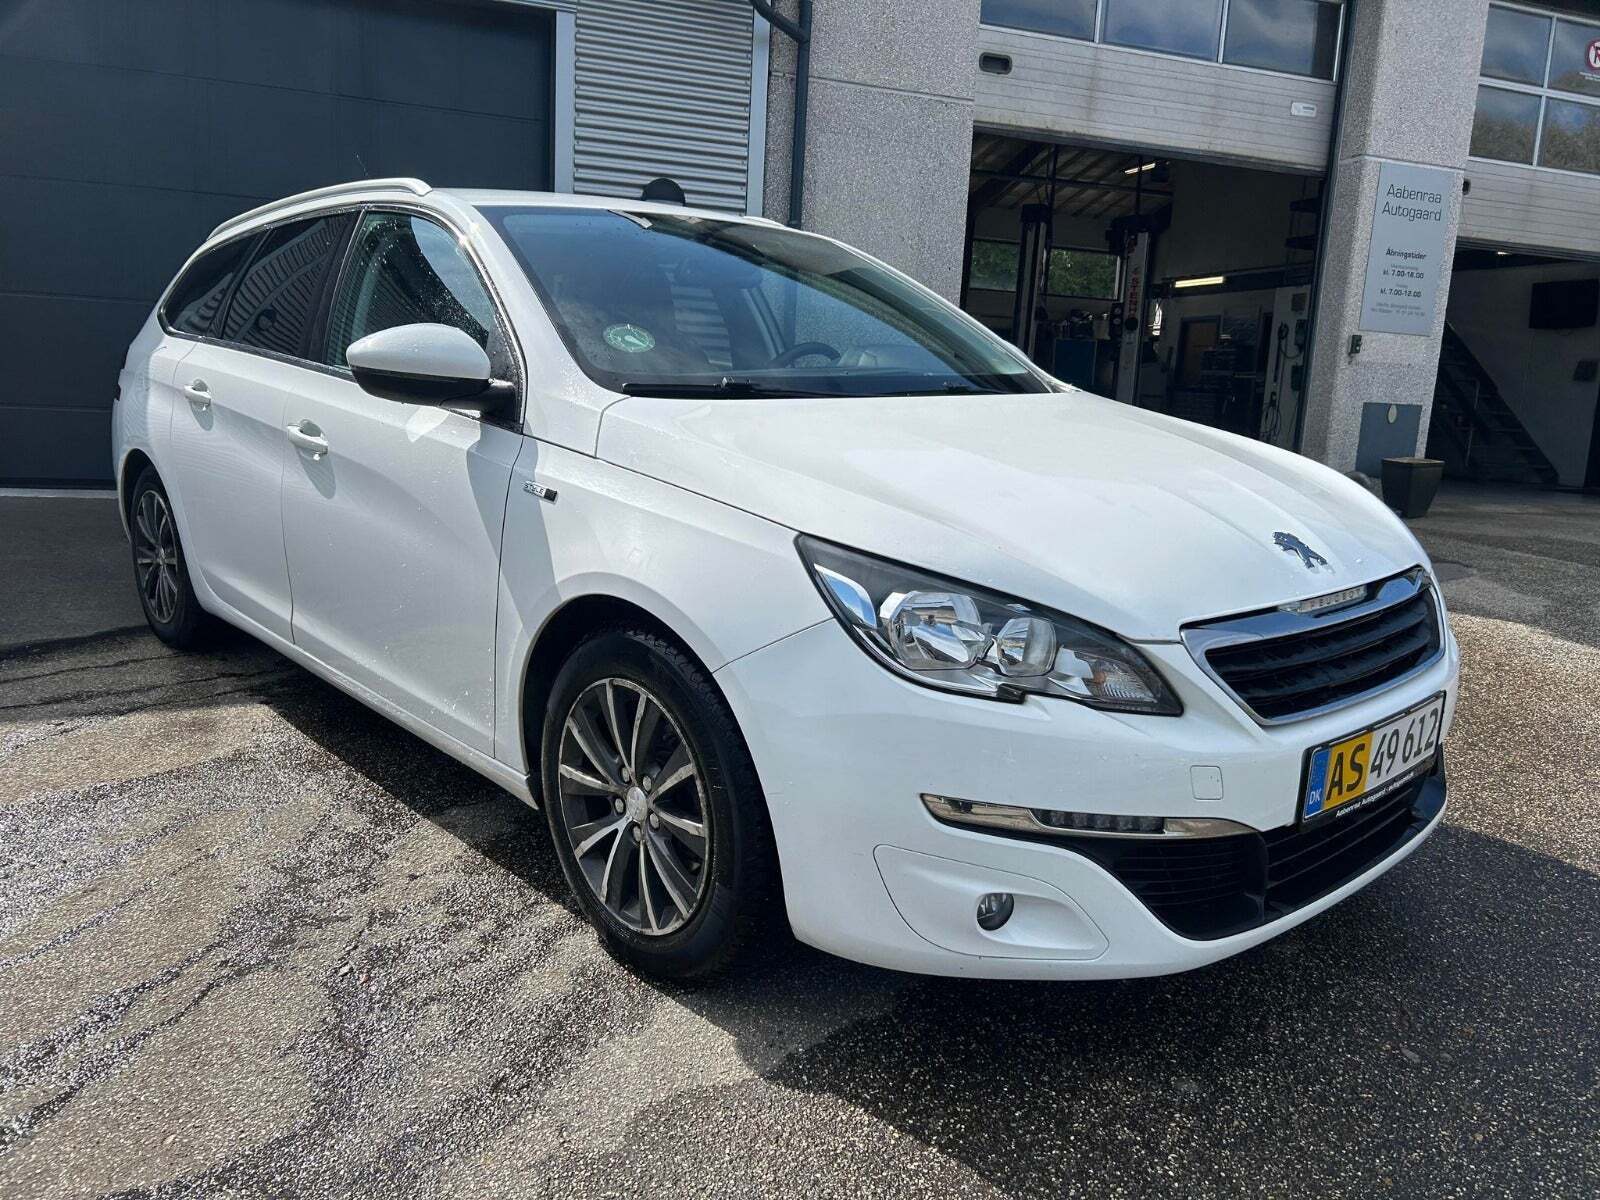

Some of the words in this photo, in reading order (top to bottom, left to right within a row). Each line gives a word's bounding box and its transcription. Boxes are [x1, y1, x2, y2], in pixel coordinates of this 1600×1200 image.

[1386, 184, 1442, 204] Aabenraa
[1382, 201, 1442, 222] Autogaard
[1309, 588, 1362, 609] PEUGEOT
[1325, 743, 1366, 801] AS
[1309, 788, 1322, 805] DK
